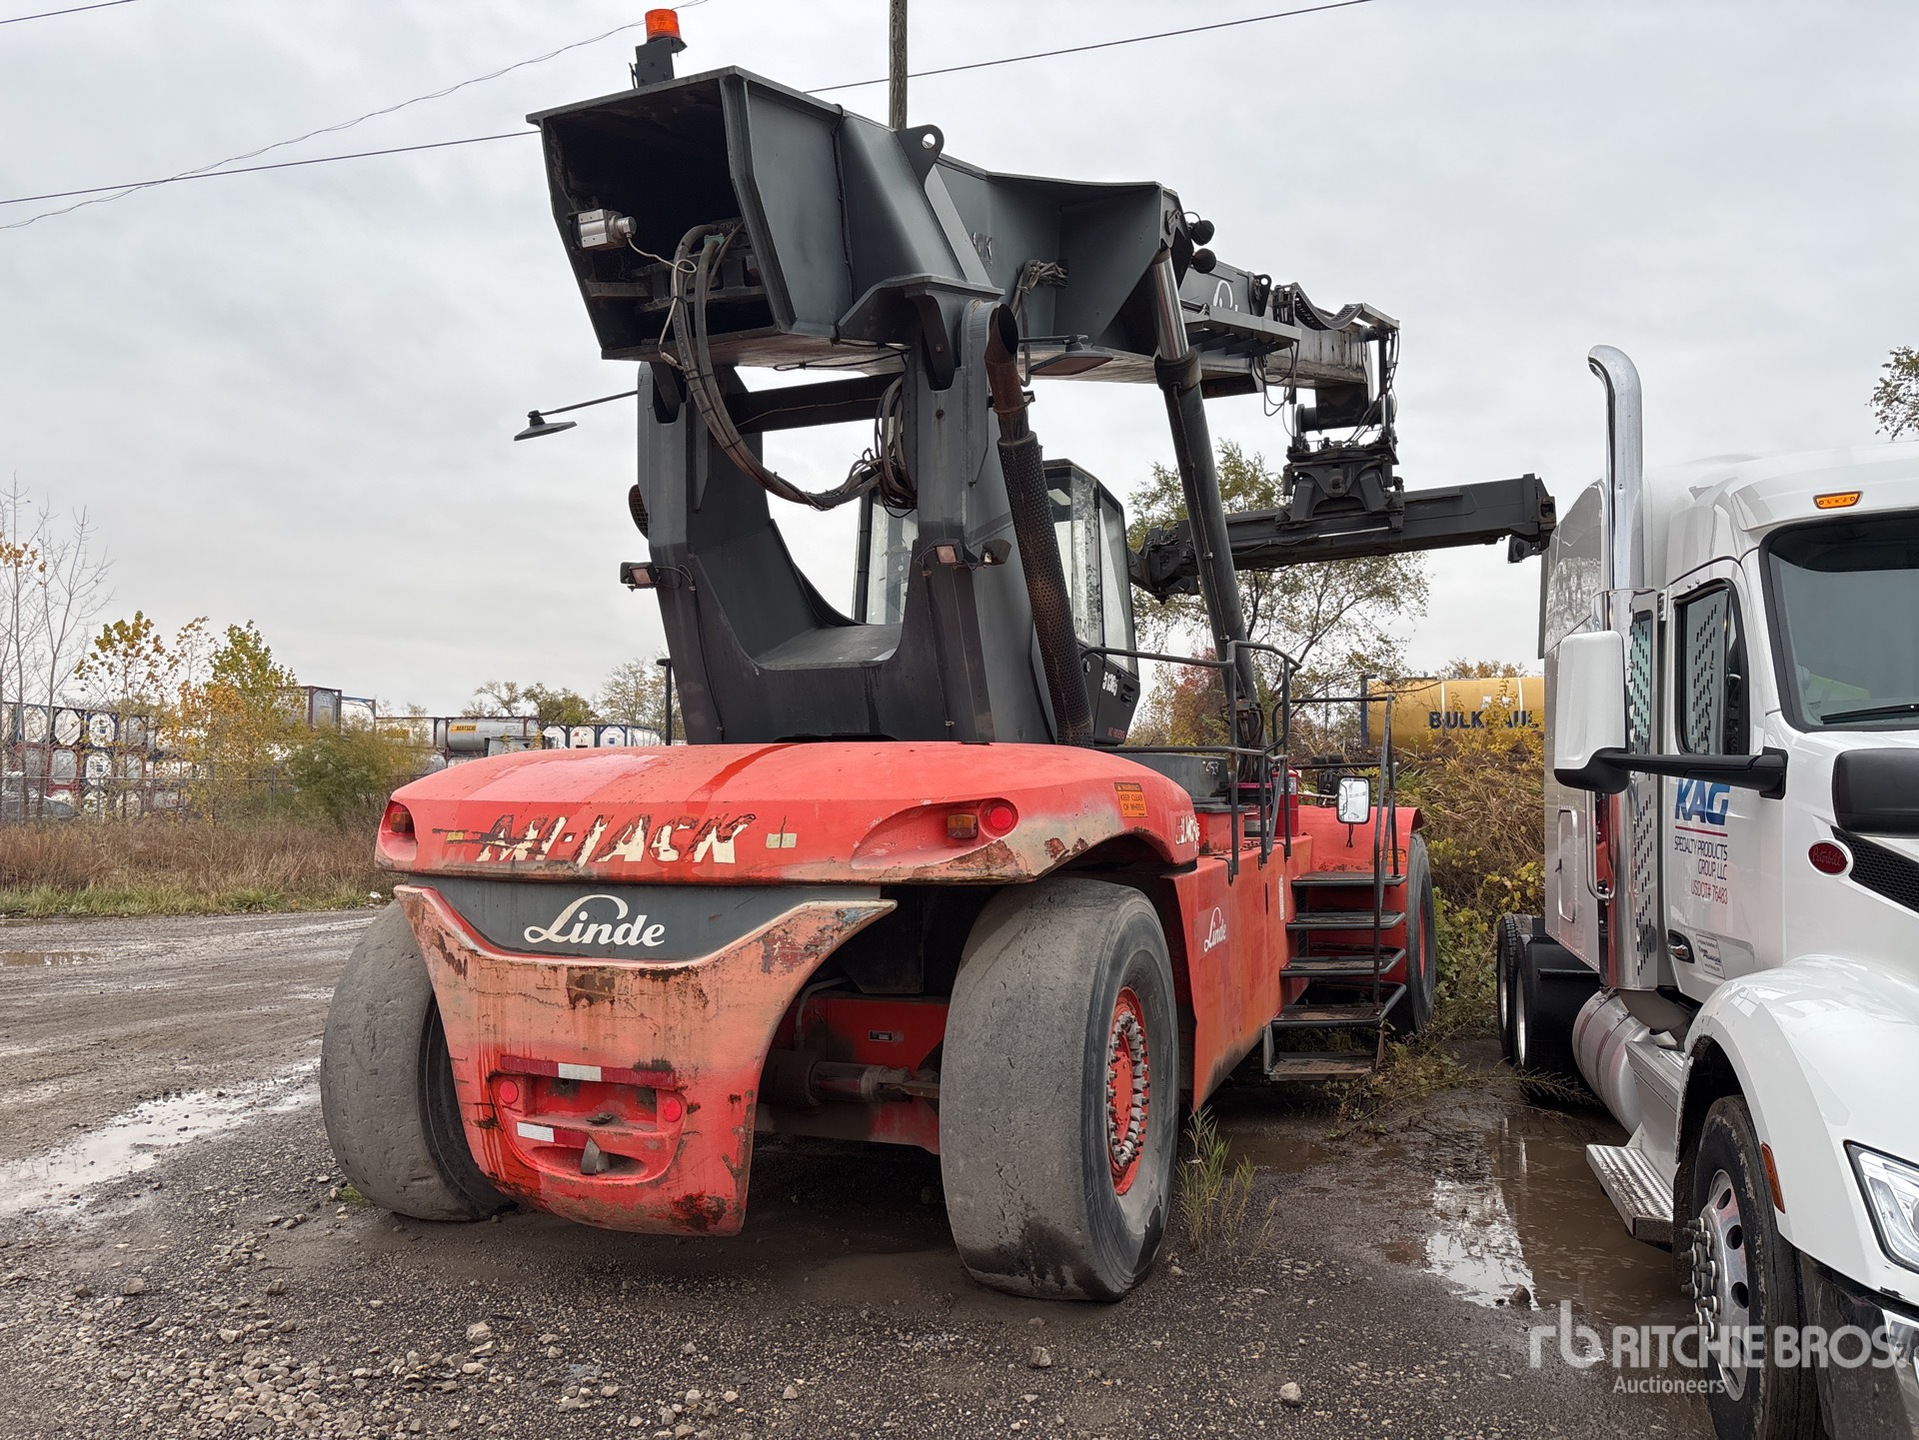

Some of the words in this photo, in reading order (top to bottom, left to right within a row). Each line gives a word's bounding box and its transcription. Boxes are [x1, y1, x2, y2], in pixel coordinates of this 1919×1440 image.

[1675, 778, 1731, 826] KAG
[1697, 840, 1728, 861] PRODUCTS
[1717, 864, 1728, 881] LLC
[523, 893, 666, 947] Linde
[1203, 906, 1228, 953] Linde
